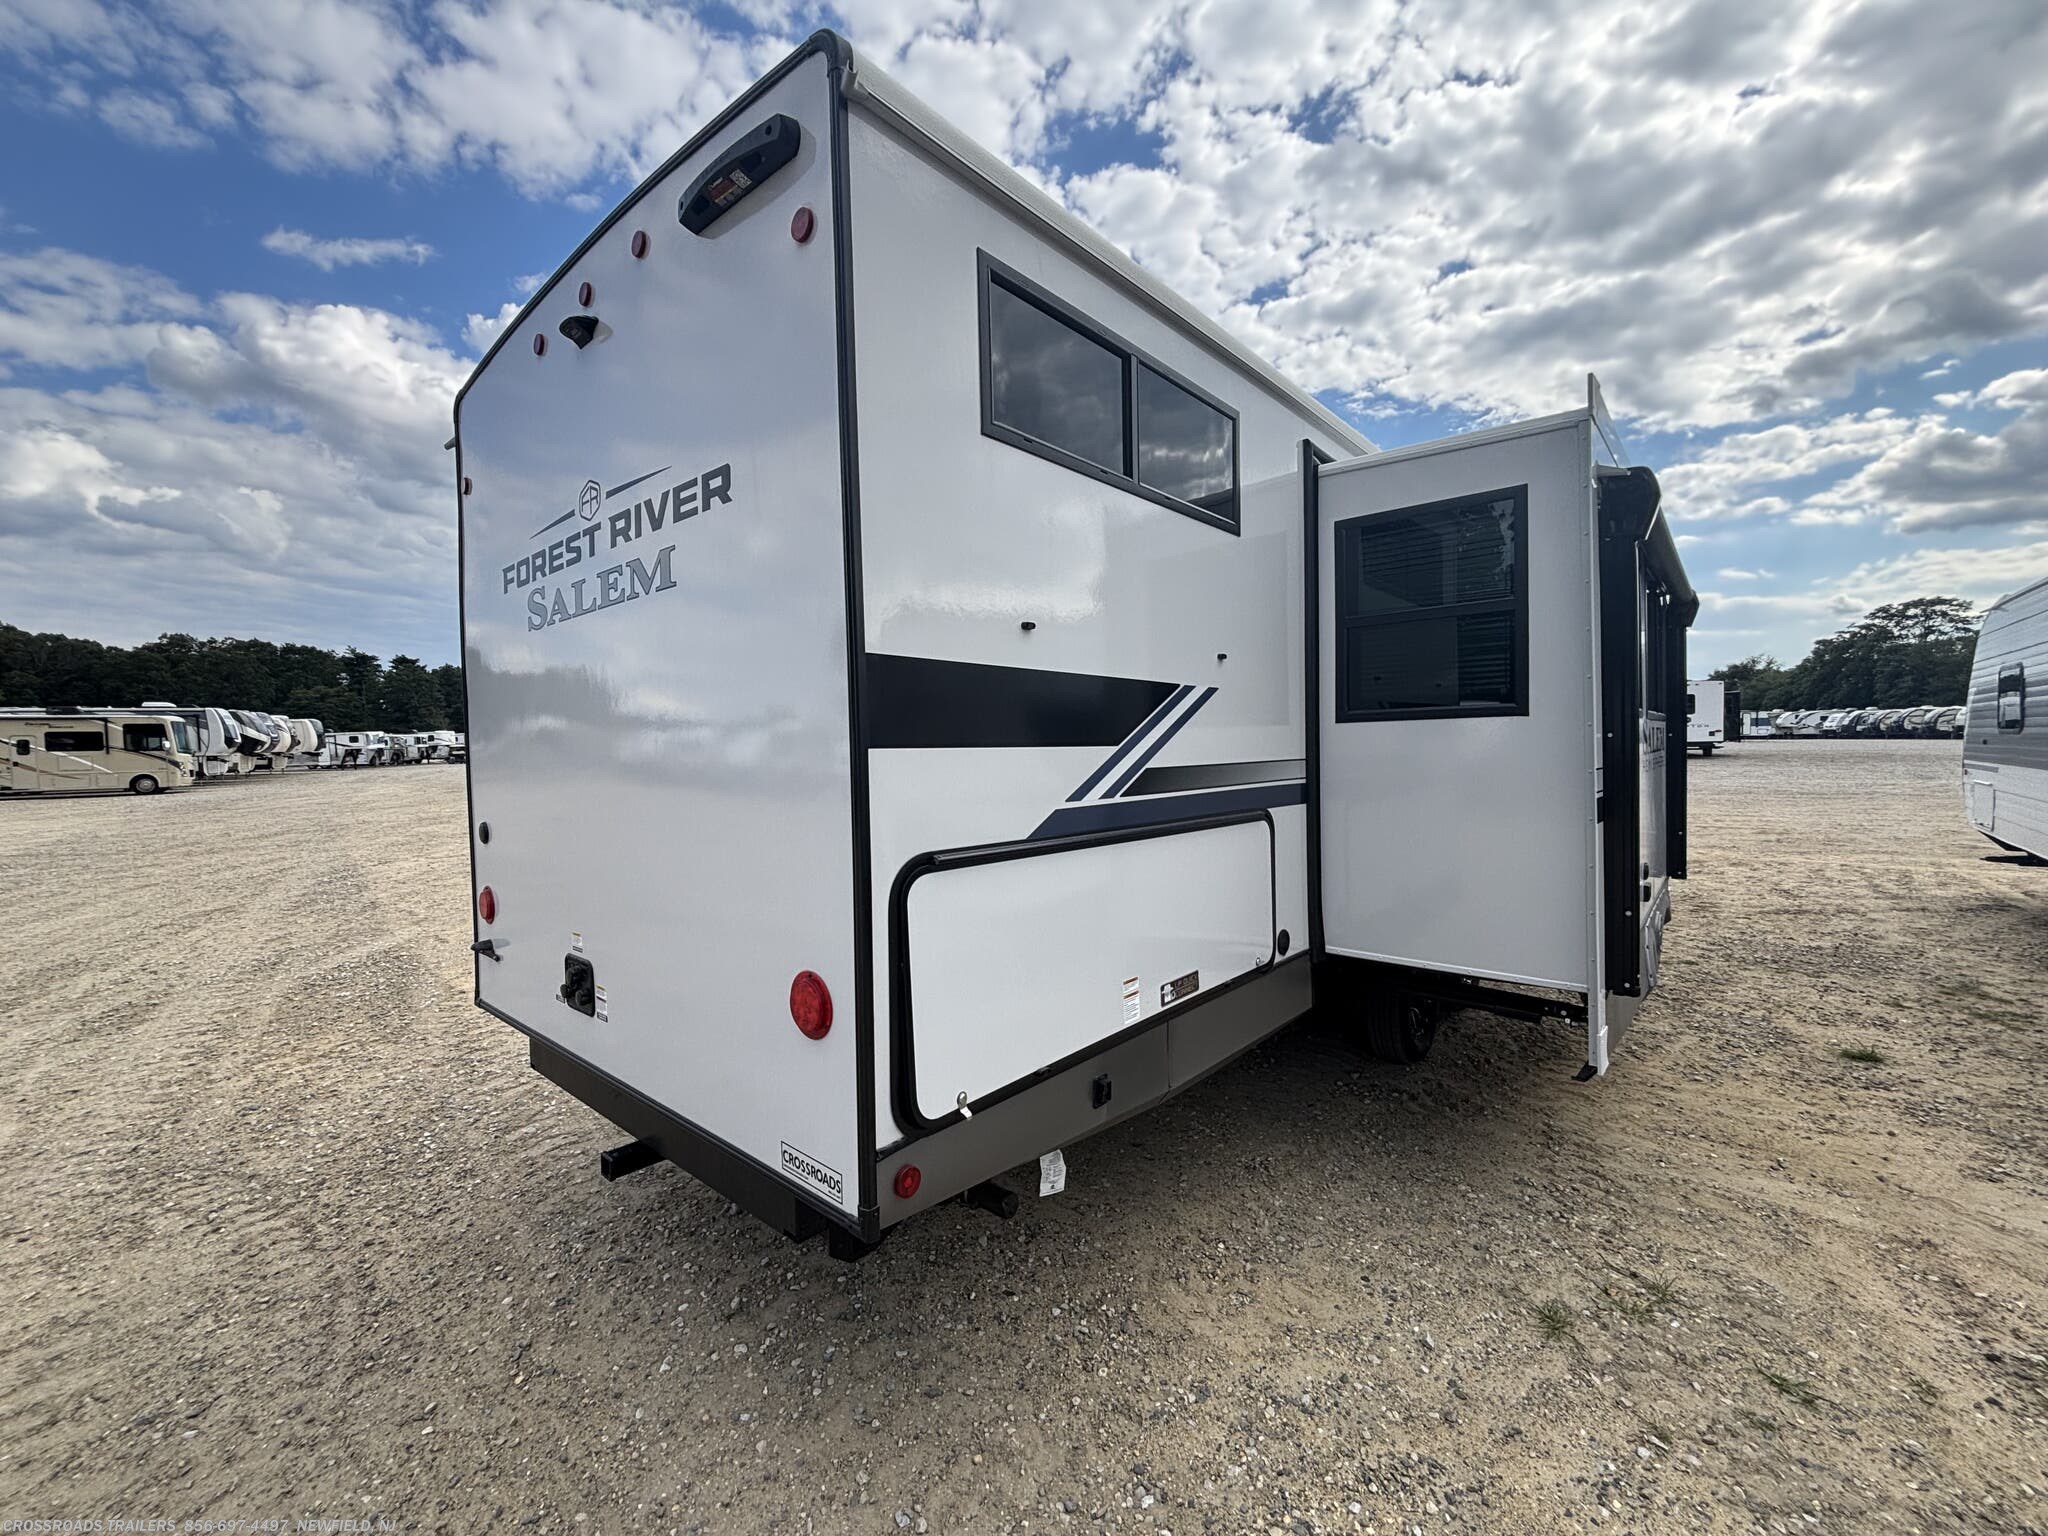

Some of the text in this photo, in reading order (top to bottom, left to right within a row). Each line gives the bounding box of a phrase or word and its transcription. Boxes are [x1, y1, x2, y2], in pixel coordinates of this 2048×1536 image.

[502, 463, 733, 594] FOREST RIVER
[527, 544, 678, 632] SALEM
[782, 1150, 841, 1194] CROSSROADS
